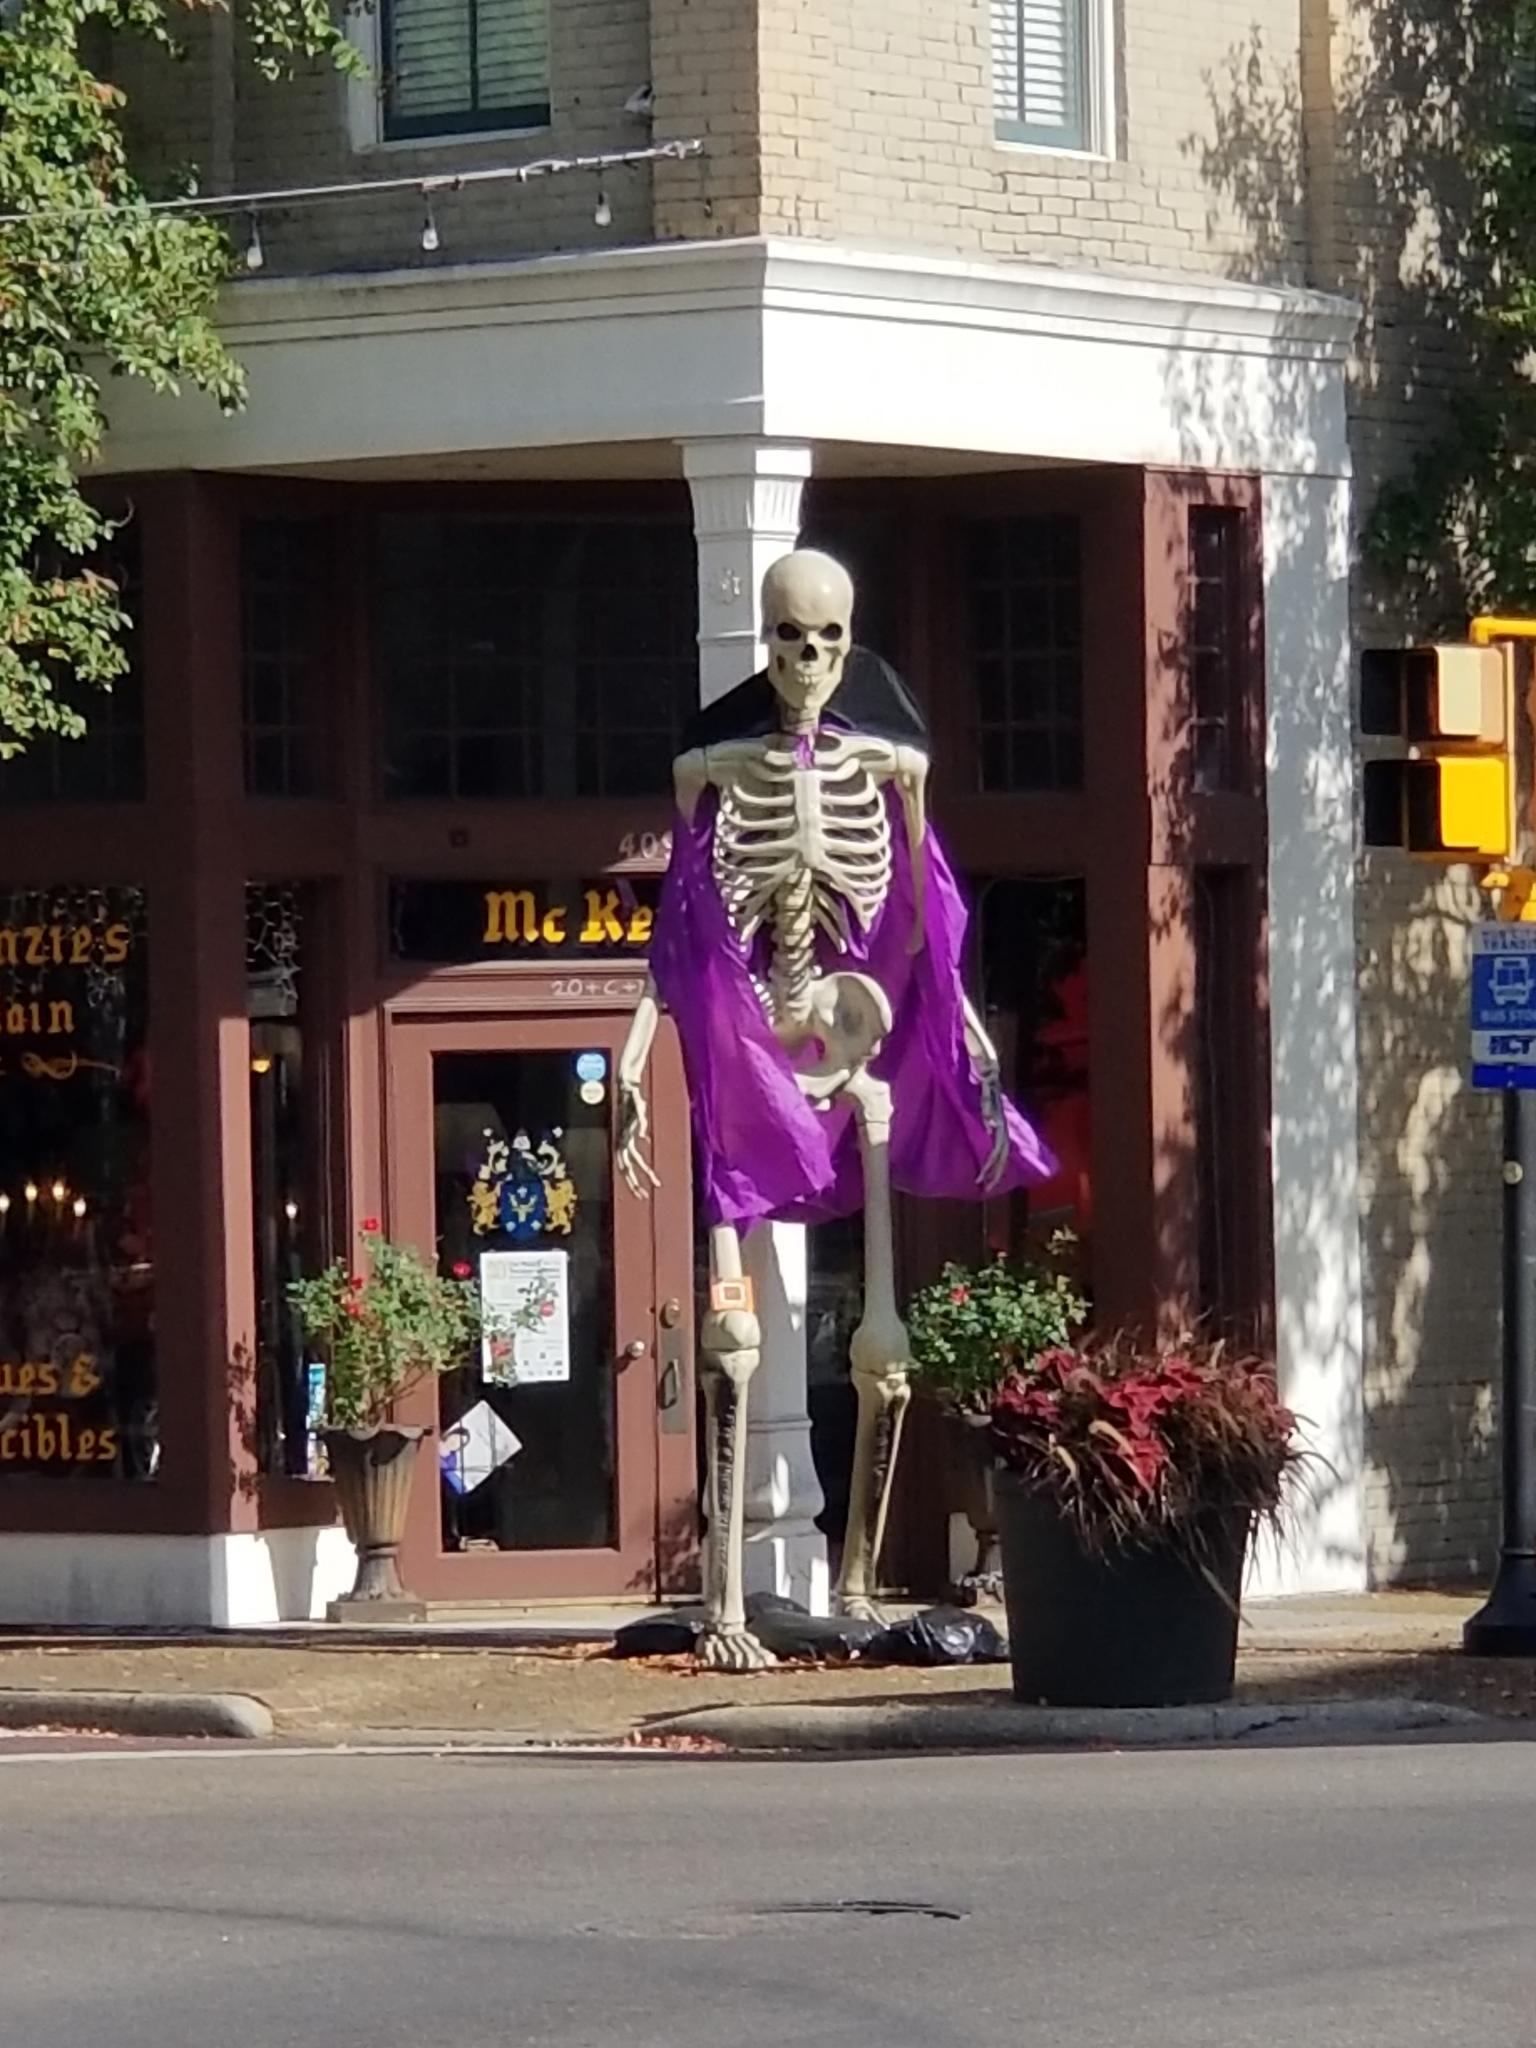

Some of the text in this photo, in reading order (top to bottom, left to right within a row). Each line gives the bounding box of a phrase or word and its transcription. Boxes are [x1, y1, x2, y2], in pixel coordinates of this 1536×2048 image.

[483, 890, 567, 943] Mc
[69, 1353, 101, 1397] &
[1, 1413, 117, 1460] cibles
